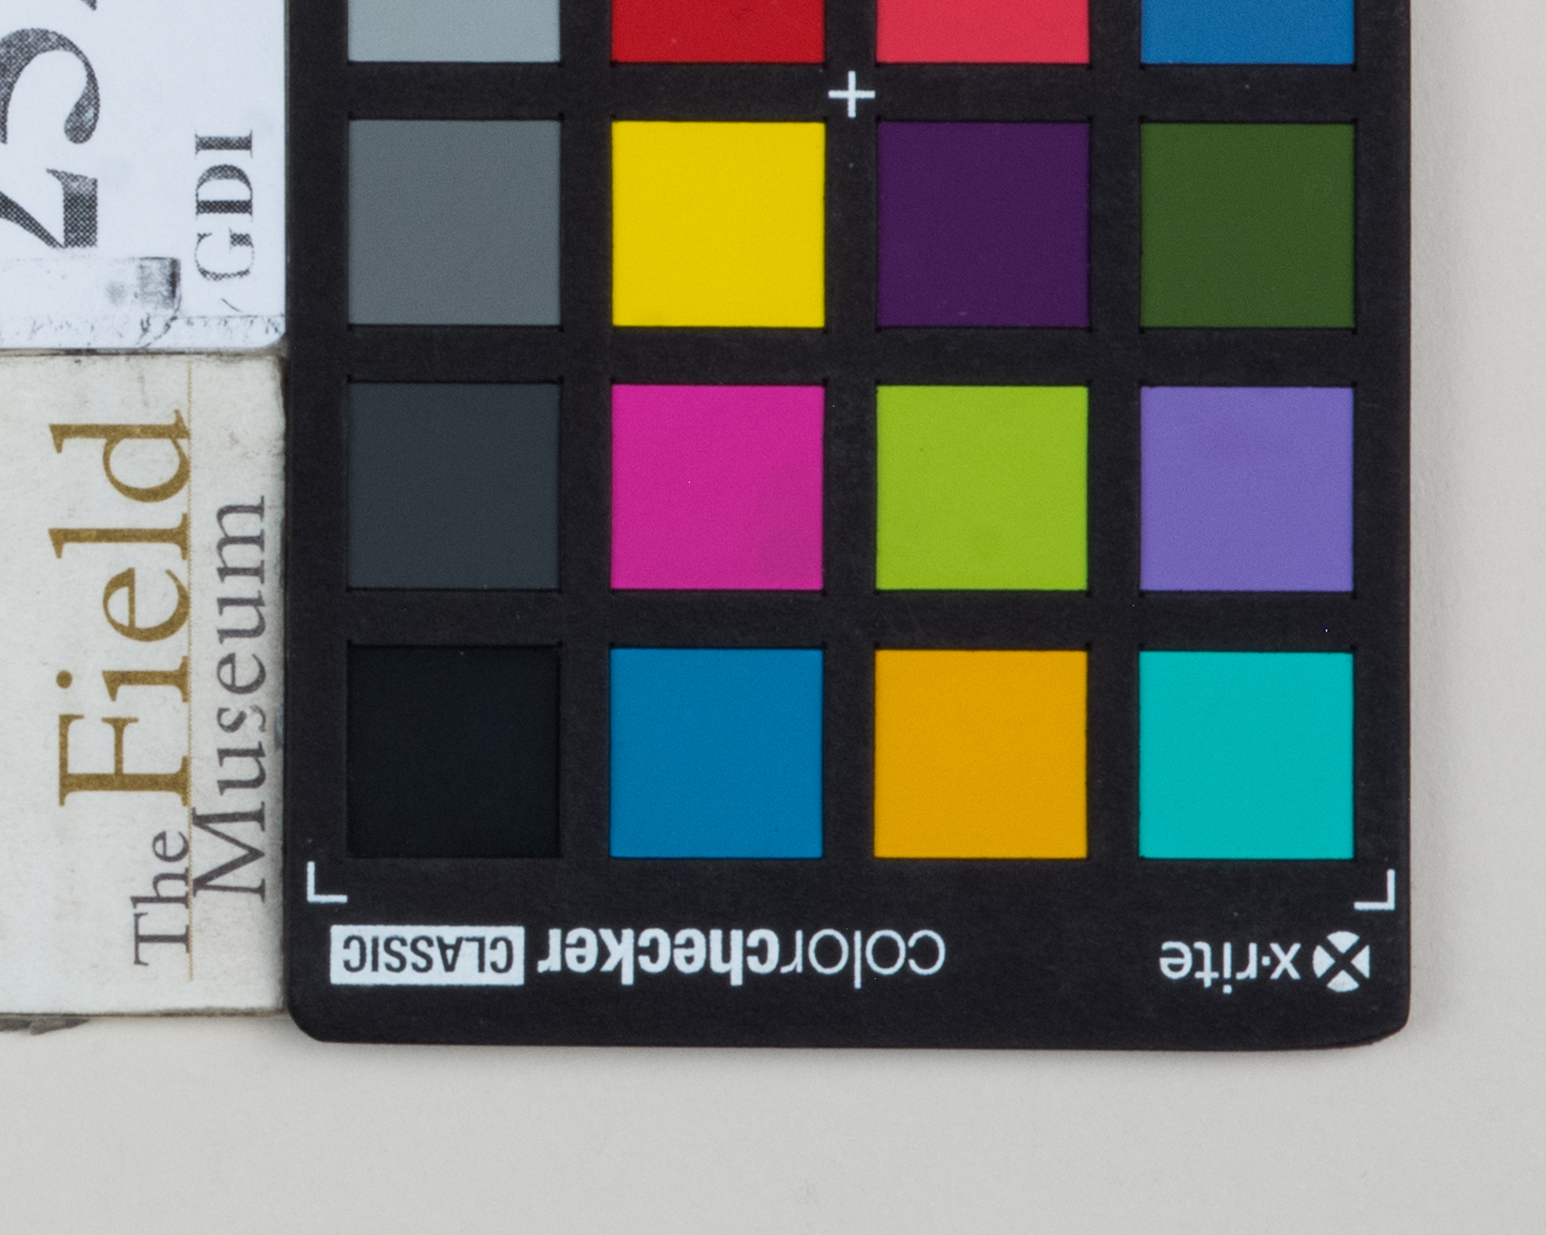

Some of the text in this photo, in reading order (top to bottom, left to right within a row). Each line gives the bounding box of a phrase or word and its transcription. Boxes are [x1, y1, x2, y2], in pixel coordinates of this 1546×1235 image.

[49, 409, 192, 966] The Field
[193, 496, 267, 902] Museum
[339, 927, 946, 989] colorchecker CLASSIC
